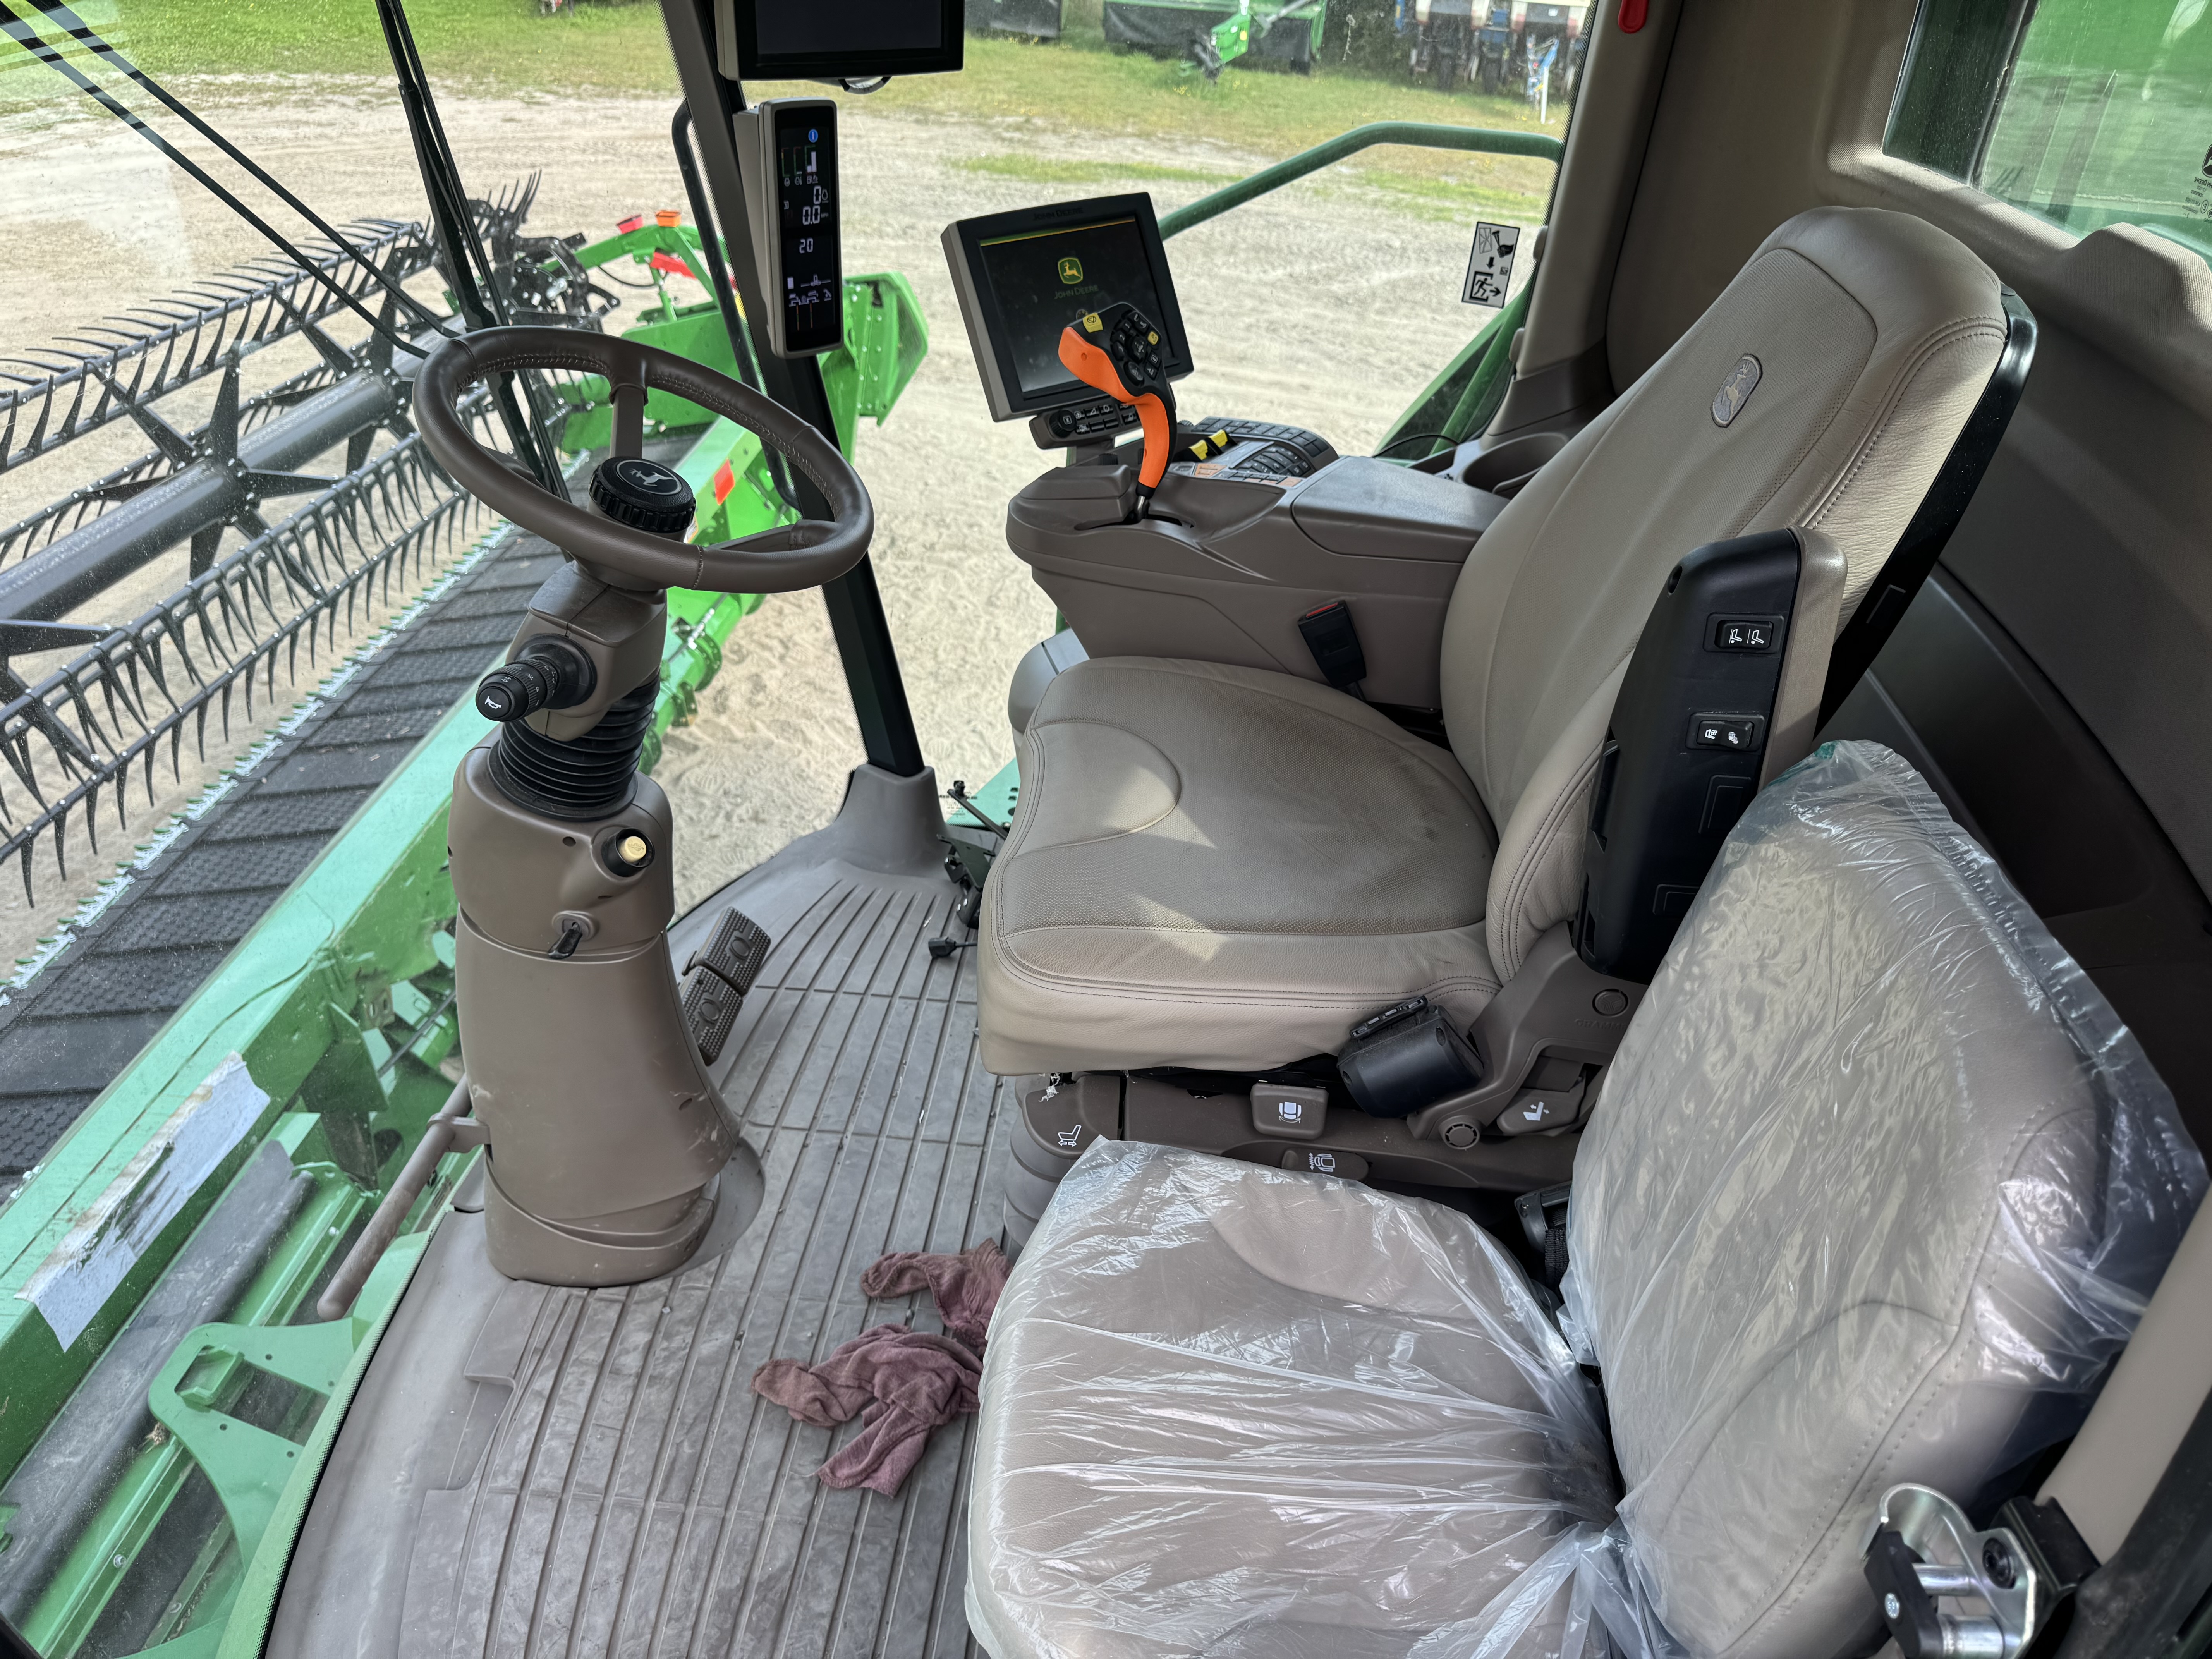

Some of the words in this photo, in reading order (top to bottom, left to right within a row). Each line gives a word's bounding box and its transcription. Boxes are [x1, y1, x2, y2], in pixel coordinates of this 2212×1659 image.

[814, 185, 821, 204] 0
[802, 205, 821, 225] 0.0
[799, 238, 813, 254] 20
[1054, 291, 1074, 299] JOHN
[1074, 285, 1099, 295] DEERE
